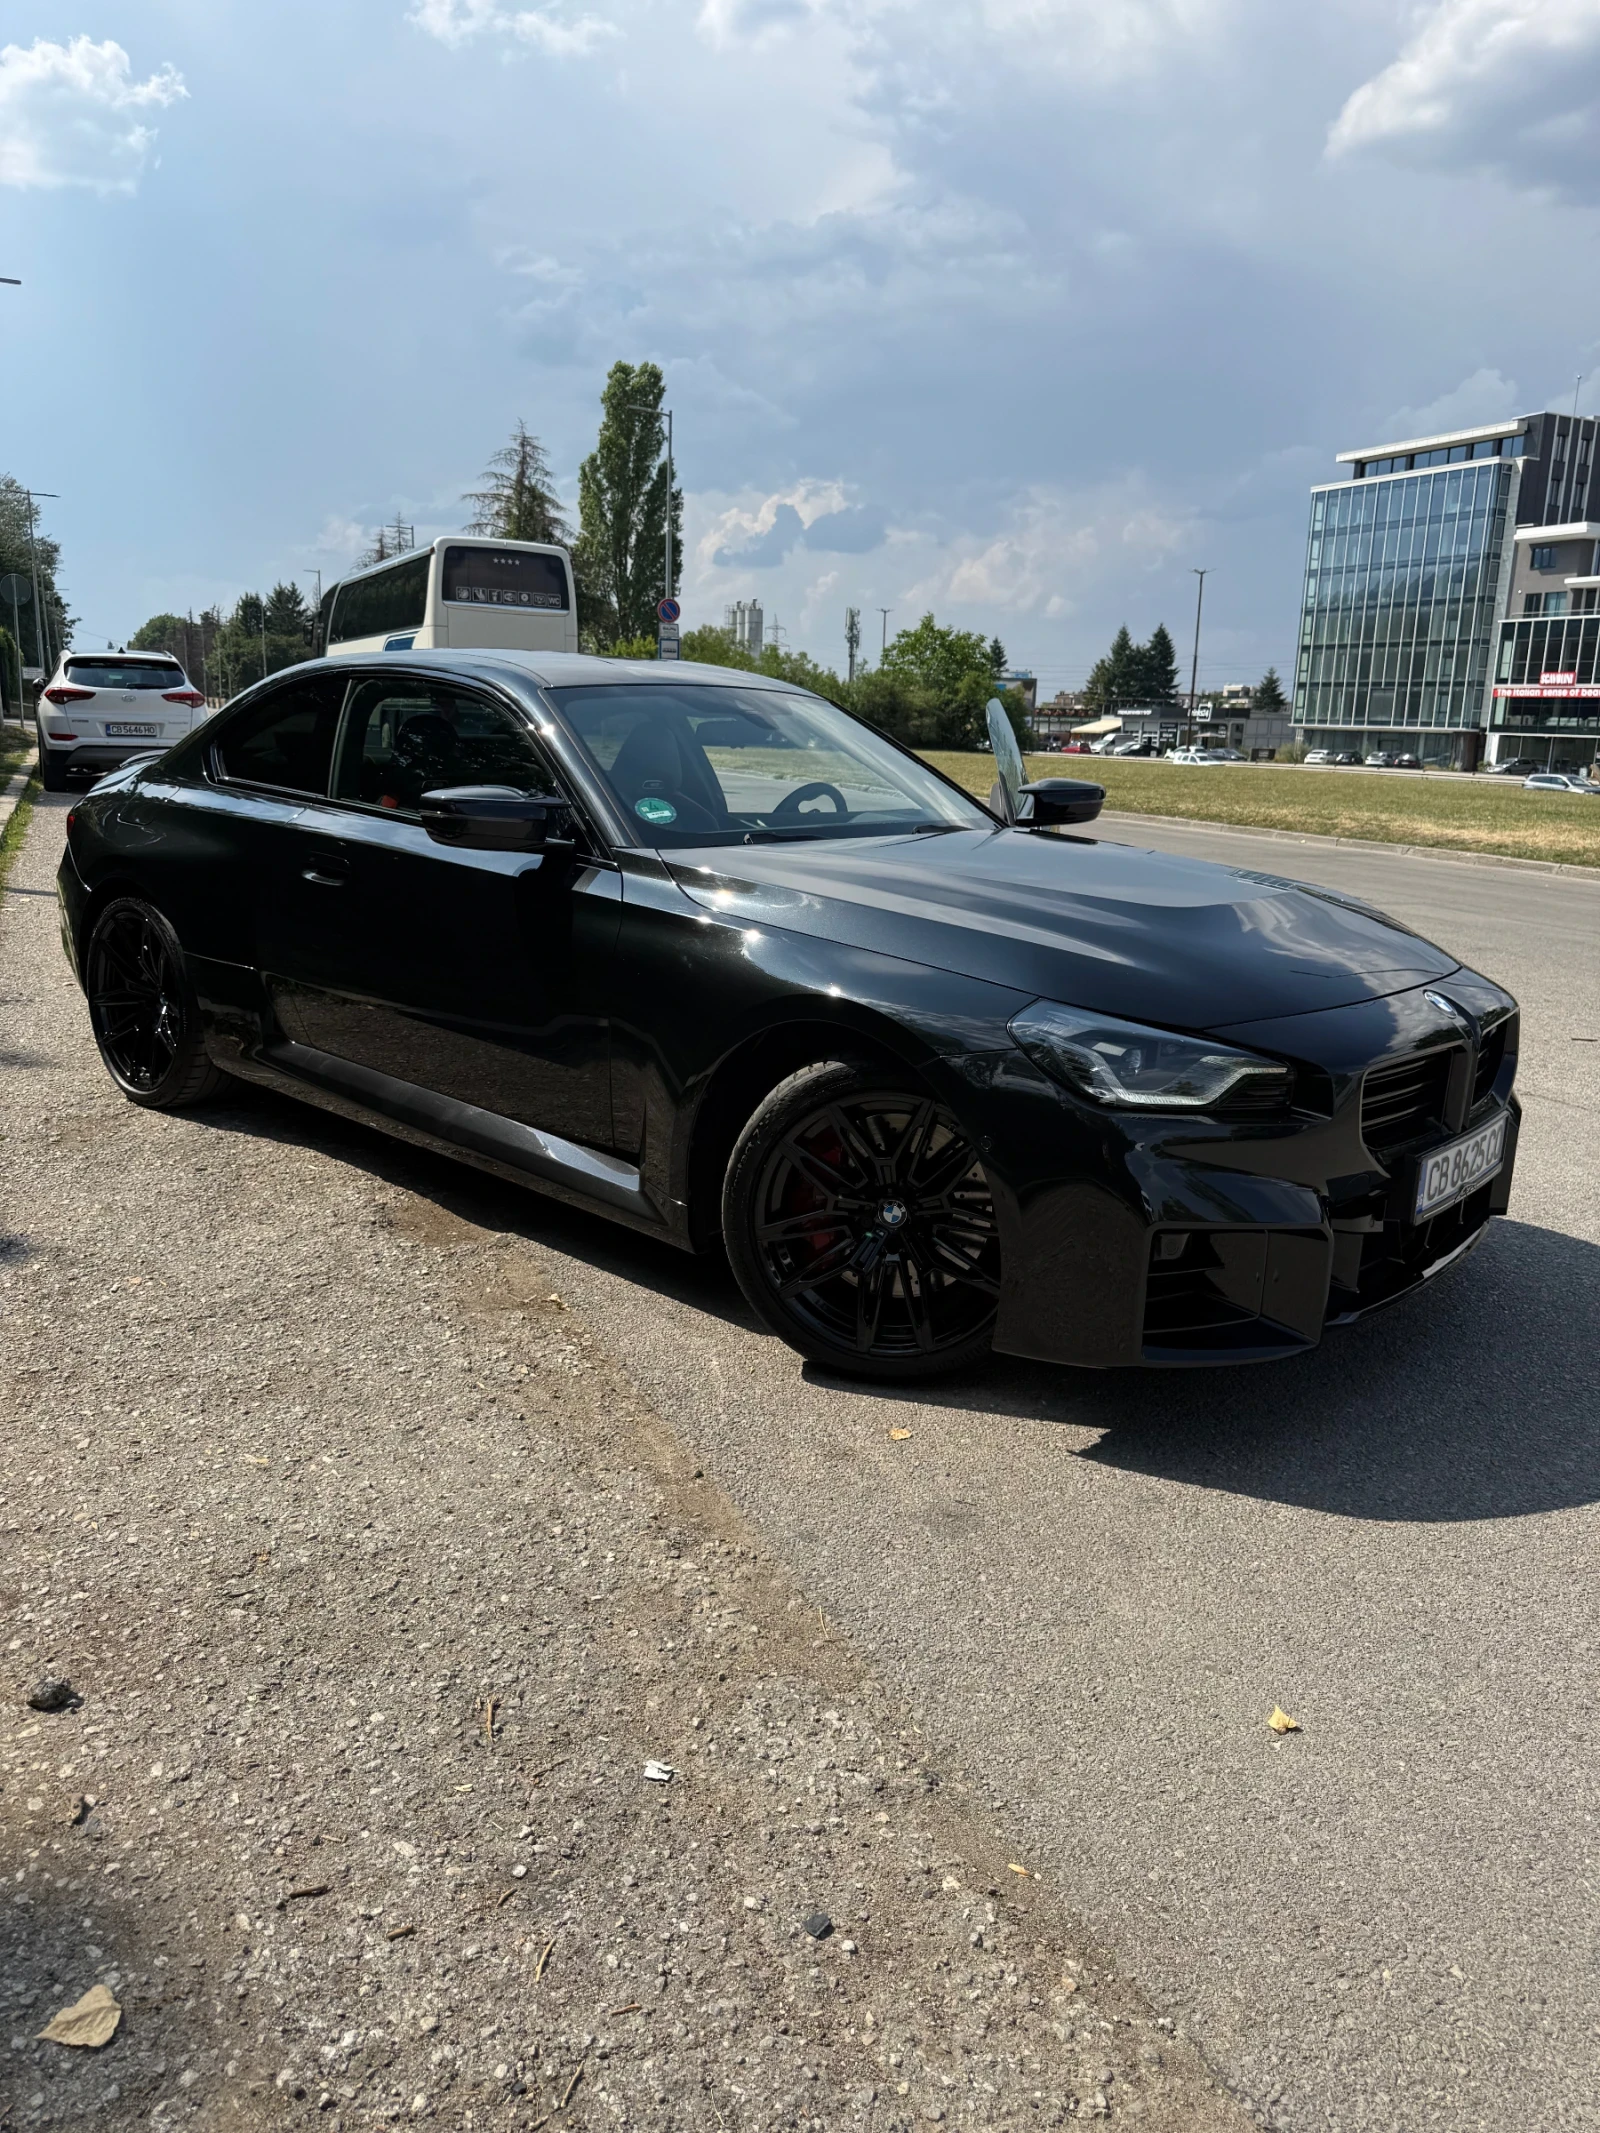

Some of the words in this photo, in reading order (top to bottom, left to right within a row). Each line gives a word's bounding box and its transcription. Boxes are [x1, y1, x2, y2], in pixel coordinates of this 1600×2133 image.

[548, 597, 560, 605] WC
[1497, 689, 1512, 697] The
[1513, 689, 1541, 697] Italian
[1542, 689, 1568, 697] sense
[1569, 688, 1580, 697] of
[1581, 688, 1600, 697] bea
[111, 725, 122, 734] CB
[123, 725, 143, 734] 5646
[1427, 1156, 1450, 1201] CB
[1450, 1134, 1487, 1188] 8625
[1486, 1123, 1503, 1166] CO
